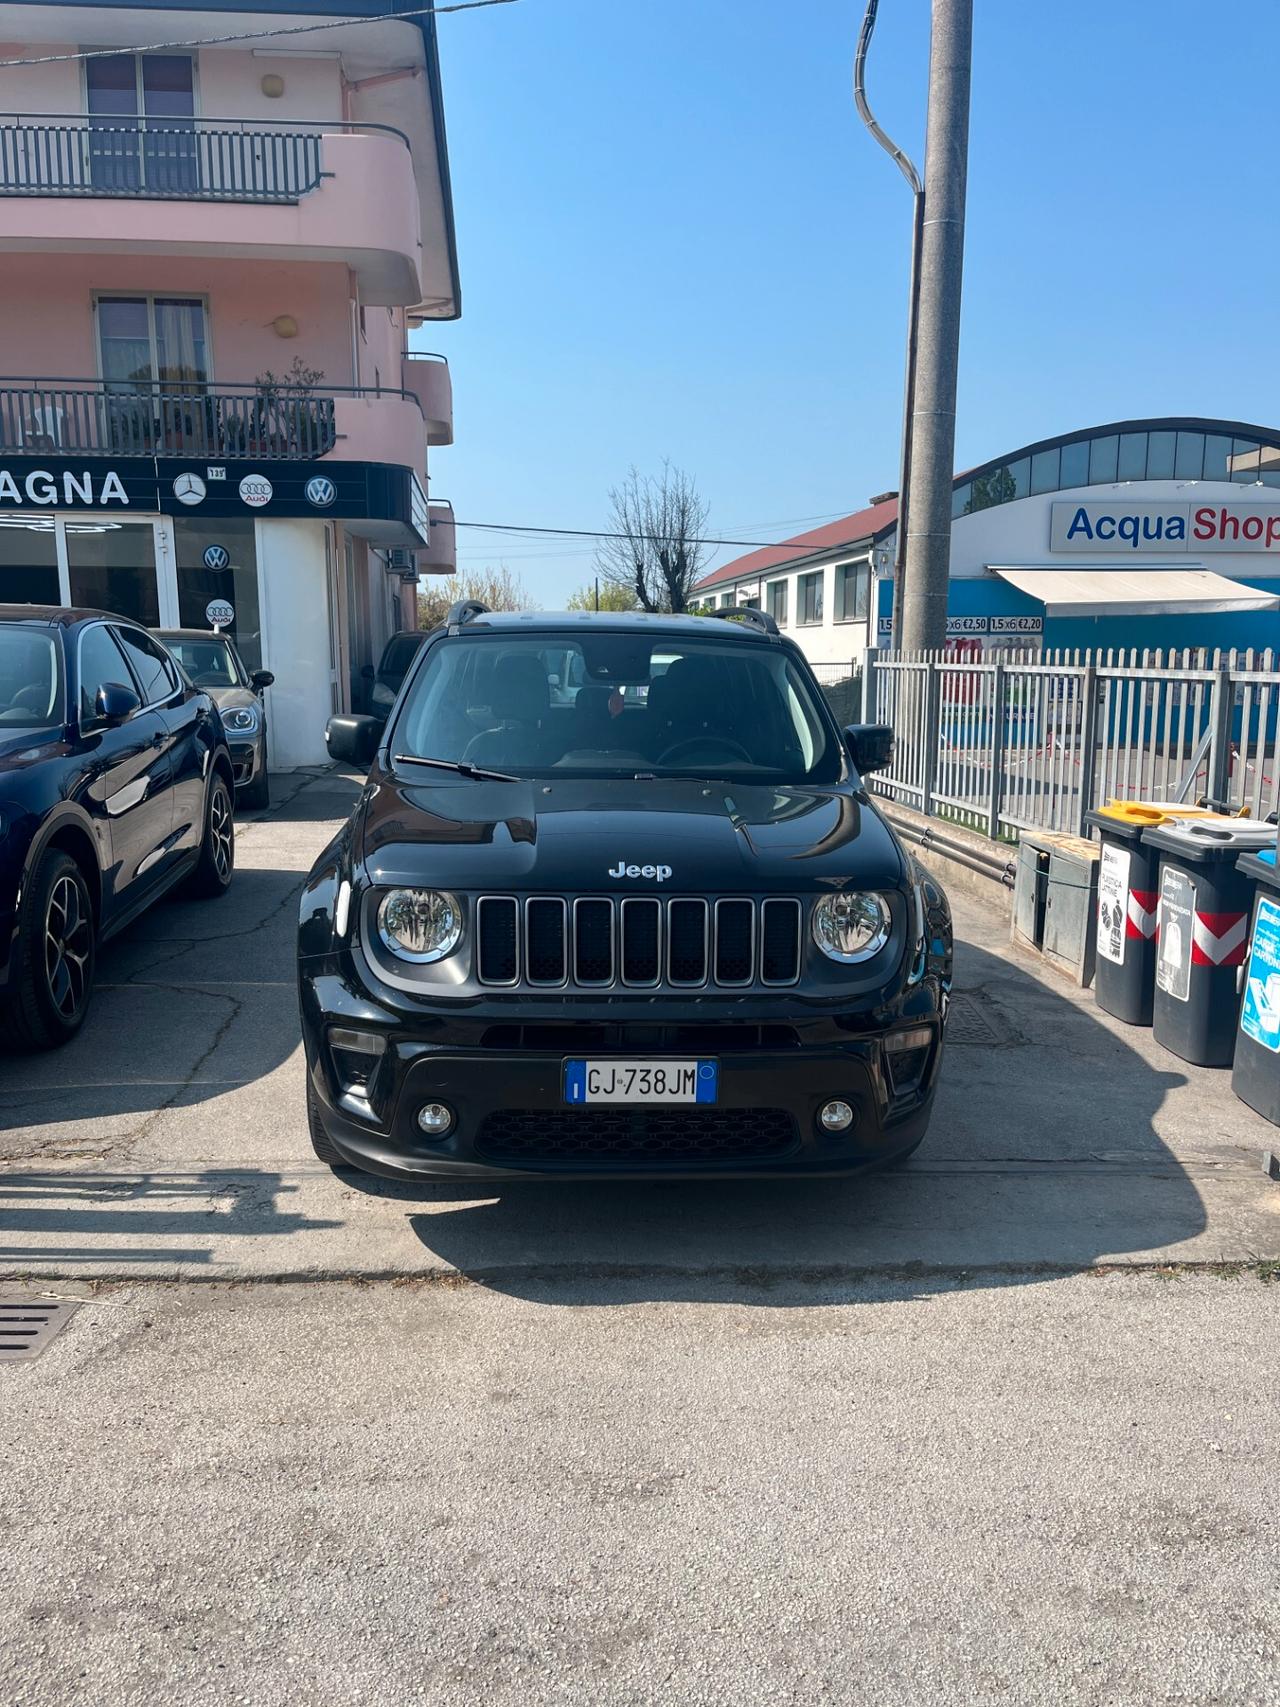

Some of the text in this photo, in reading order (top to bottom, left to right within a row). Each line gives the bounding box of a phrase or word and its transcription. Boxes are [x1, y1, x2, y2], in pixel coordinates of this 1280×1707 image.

[245, 494, 268, 502] Audi
[1067, 508, 1280, 547] Acqua Shop
[963, 619, 986, 630] €2,50
[992, 619, 1004, 630] 1,5
[1018, 619, 1041, 630] €2,20
[608, 861, 673, 882] Jeep
